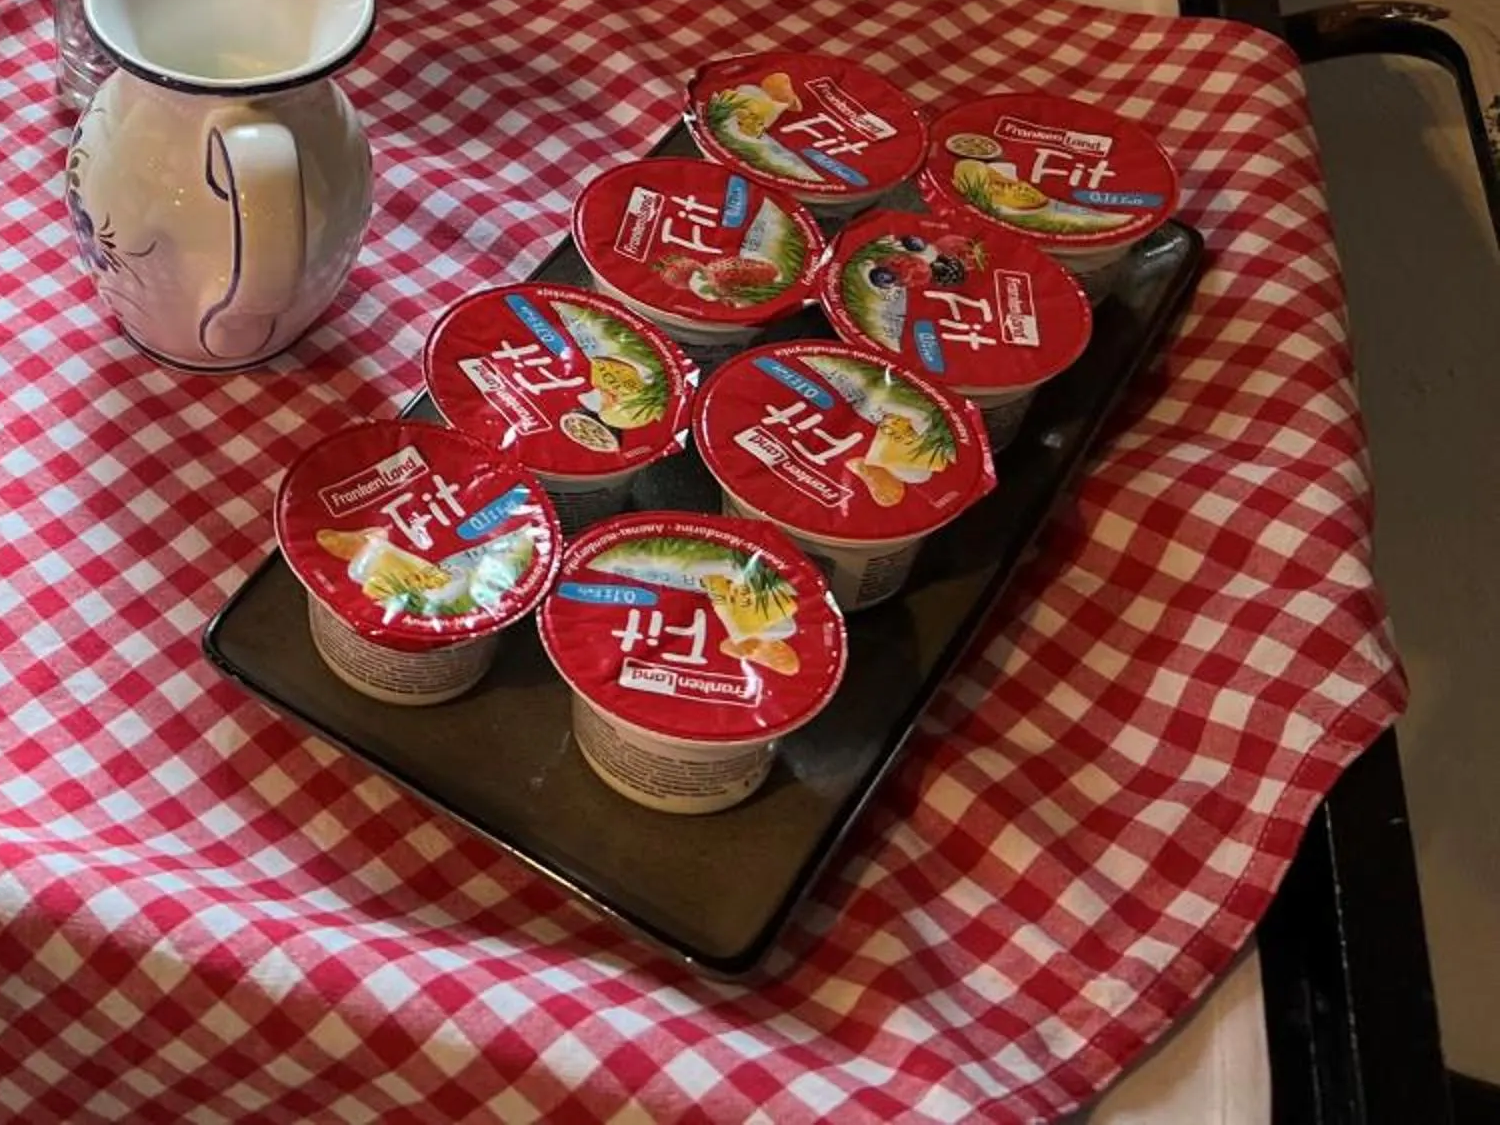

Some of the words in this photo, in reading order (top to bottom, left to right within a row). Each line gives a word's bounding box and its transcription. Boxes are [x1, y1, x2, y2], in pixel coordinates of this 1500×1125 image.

[779, 112, 869, 156] Fit
[1031, 147, 1117, 189] Fit
[661, 194, 724, 255] Fit
[922, 290, 997, 350] Fit
[491, 339, 586, 395] Fit
[761, 401, 864, 466] Fit
[380, 474, 466, 550] Fit
[611, 608, 708, 665] Fit
